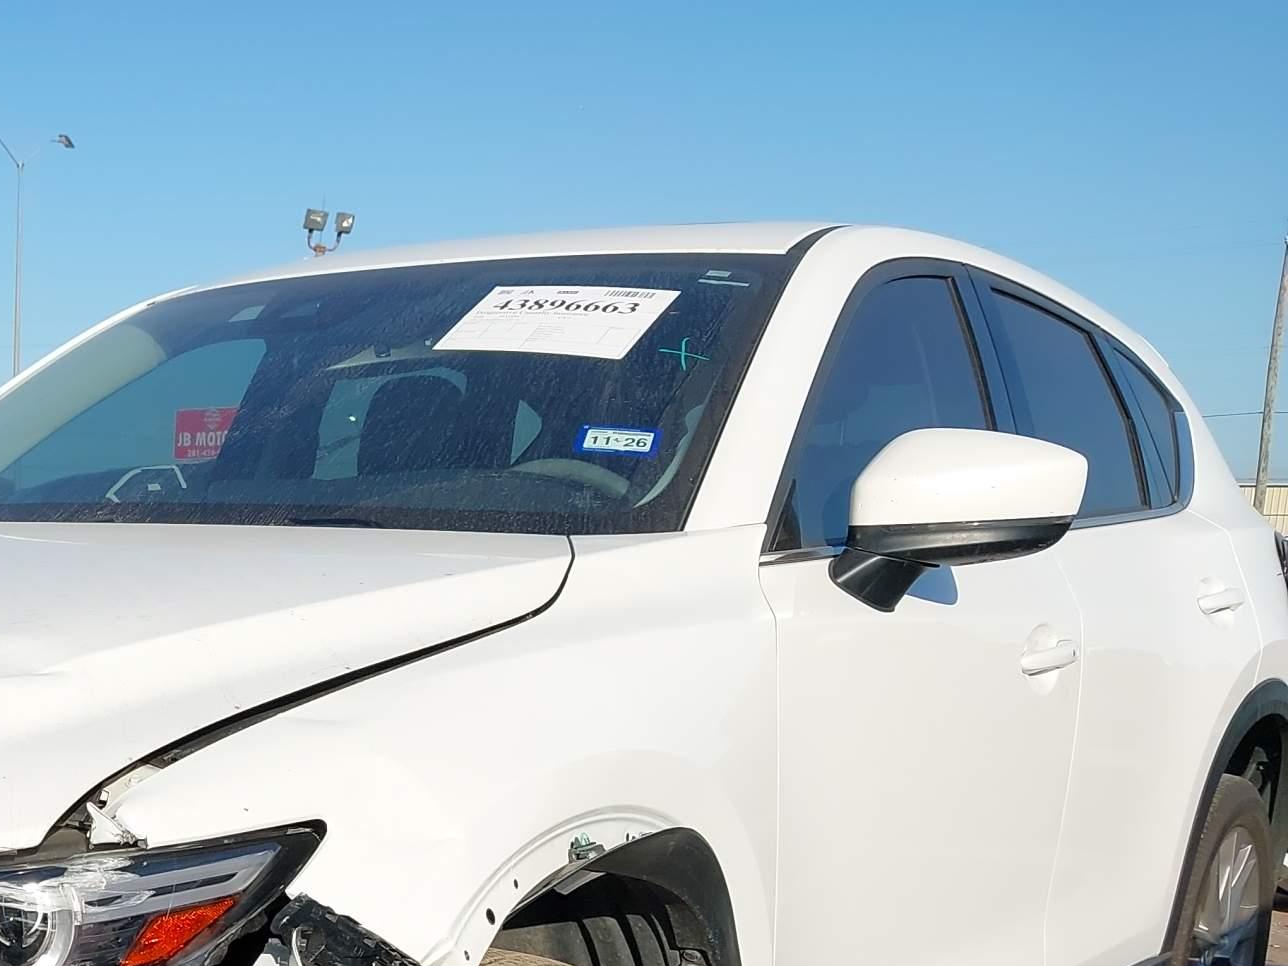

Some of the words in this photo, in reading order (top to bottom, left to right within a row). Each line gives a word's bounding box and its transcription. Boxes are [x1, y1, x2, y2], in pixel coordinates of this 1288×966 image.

[493, 298, 642, 315] 43896663
[177, 432, 192, 447] JB
[590, 435, 612, 446] 11
[622, 437, 649, 448] 26
